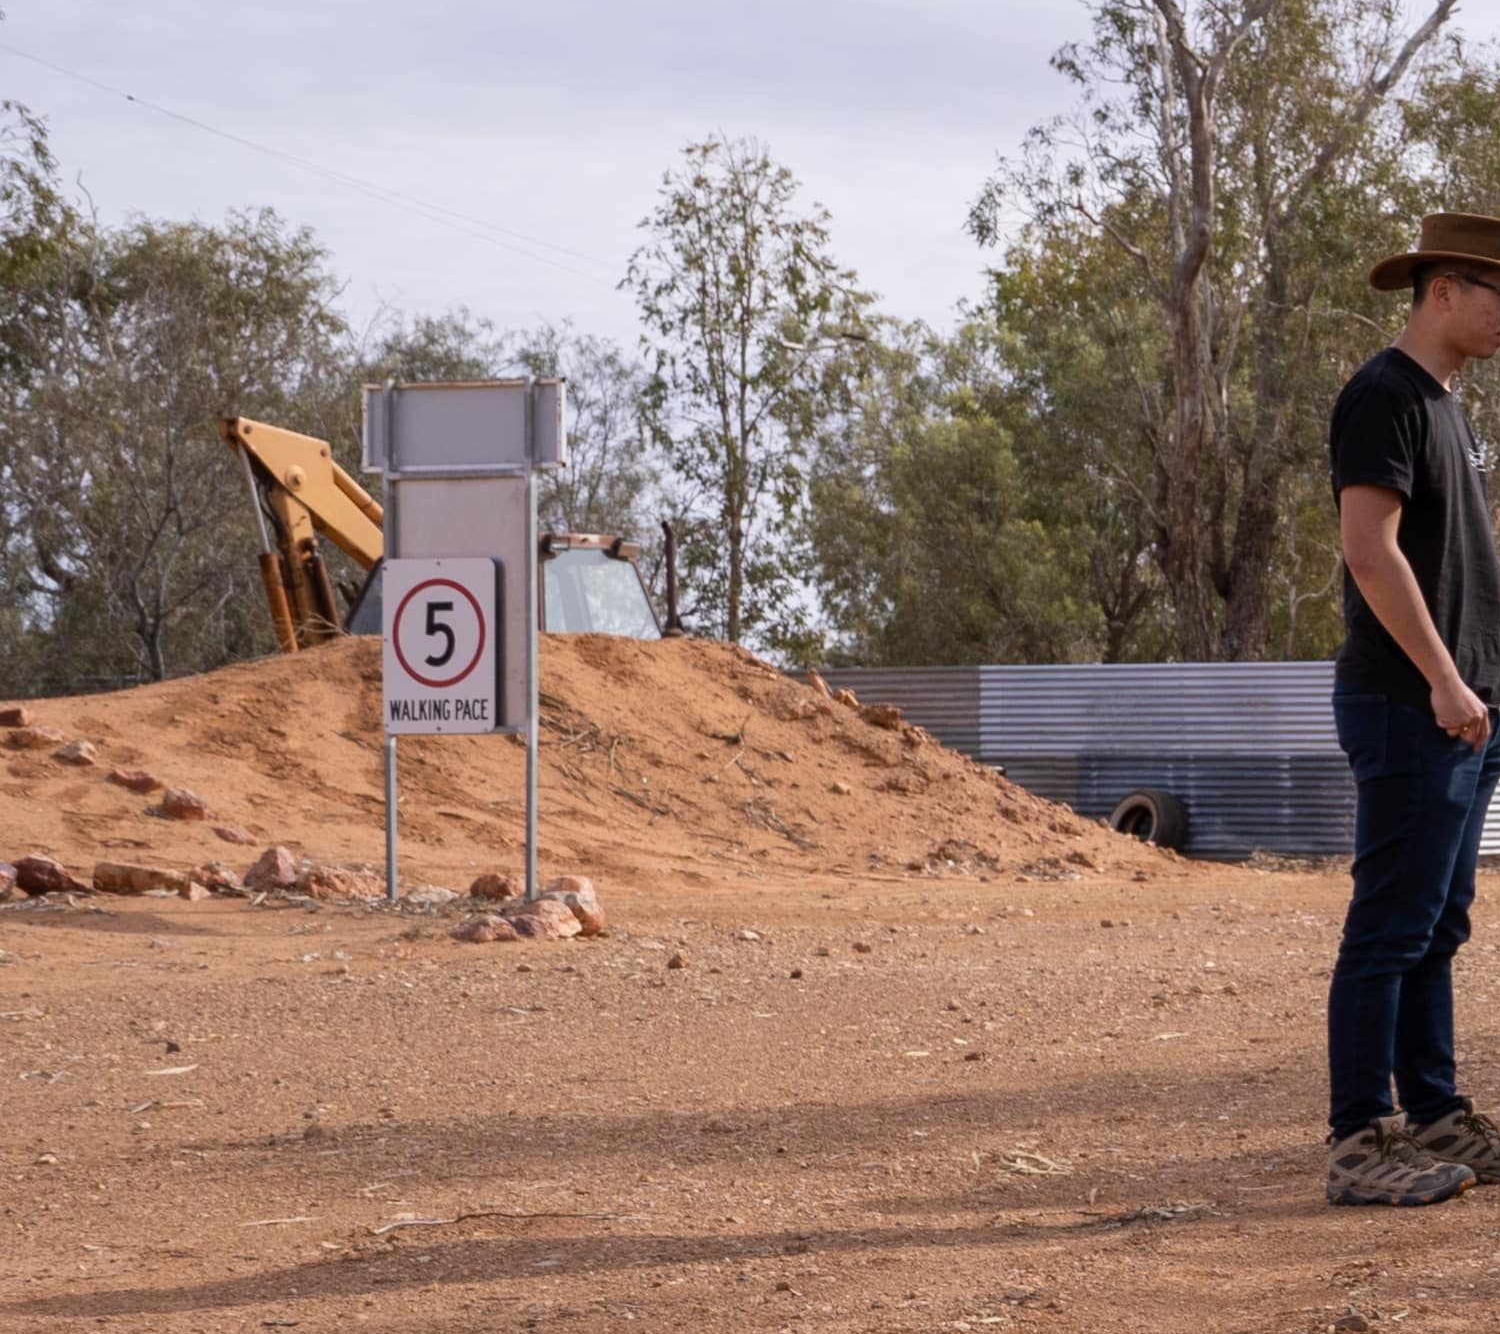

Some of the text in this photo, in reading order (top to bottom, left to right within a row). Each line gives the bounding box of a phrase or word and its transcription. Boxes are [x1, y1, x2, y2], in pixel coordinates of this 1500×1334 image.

[425, 601, 455, 667] 5
[390, 699, 488, 721] WALKING PACE
